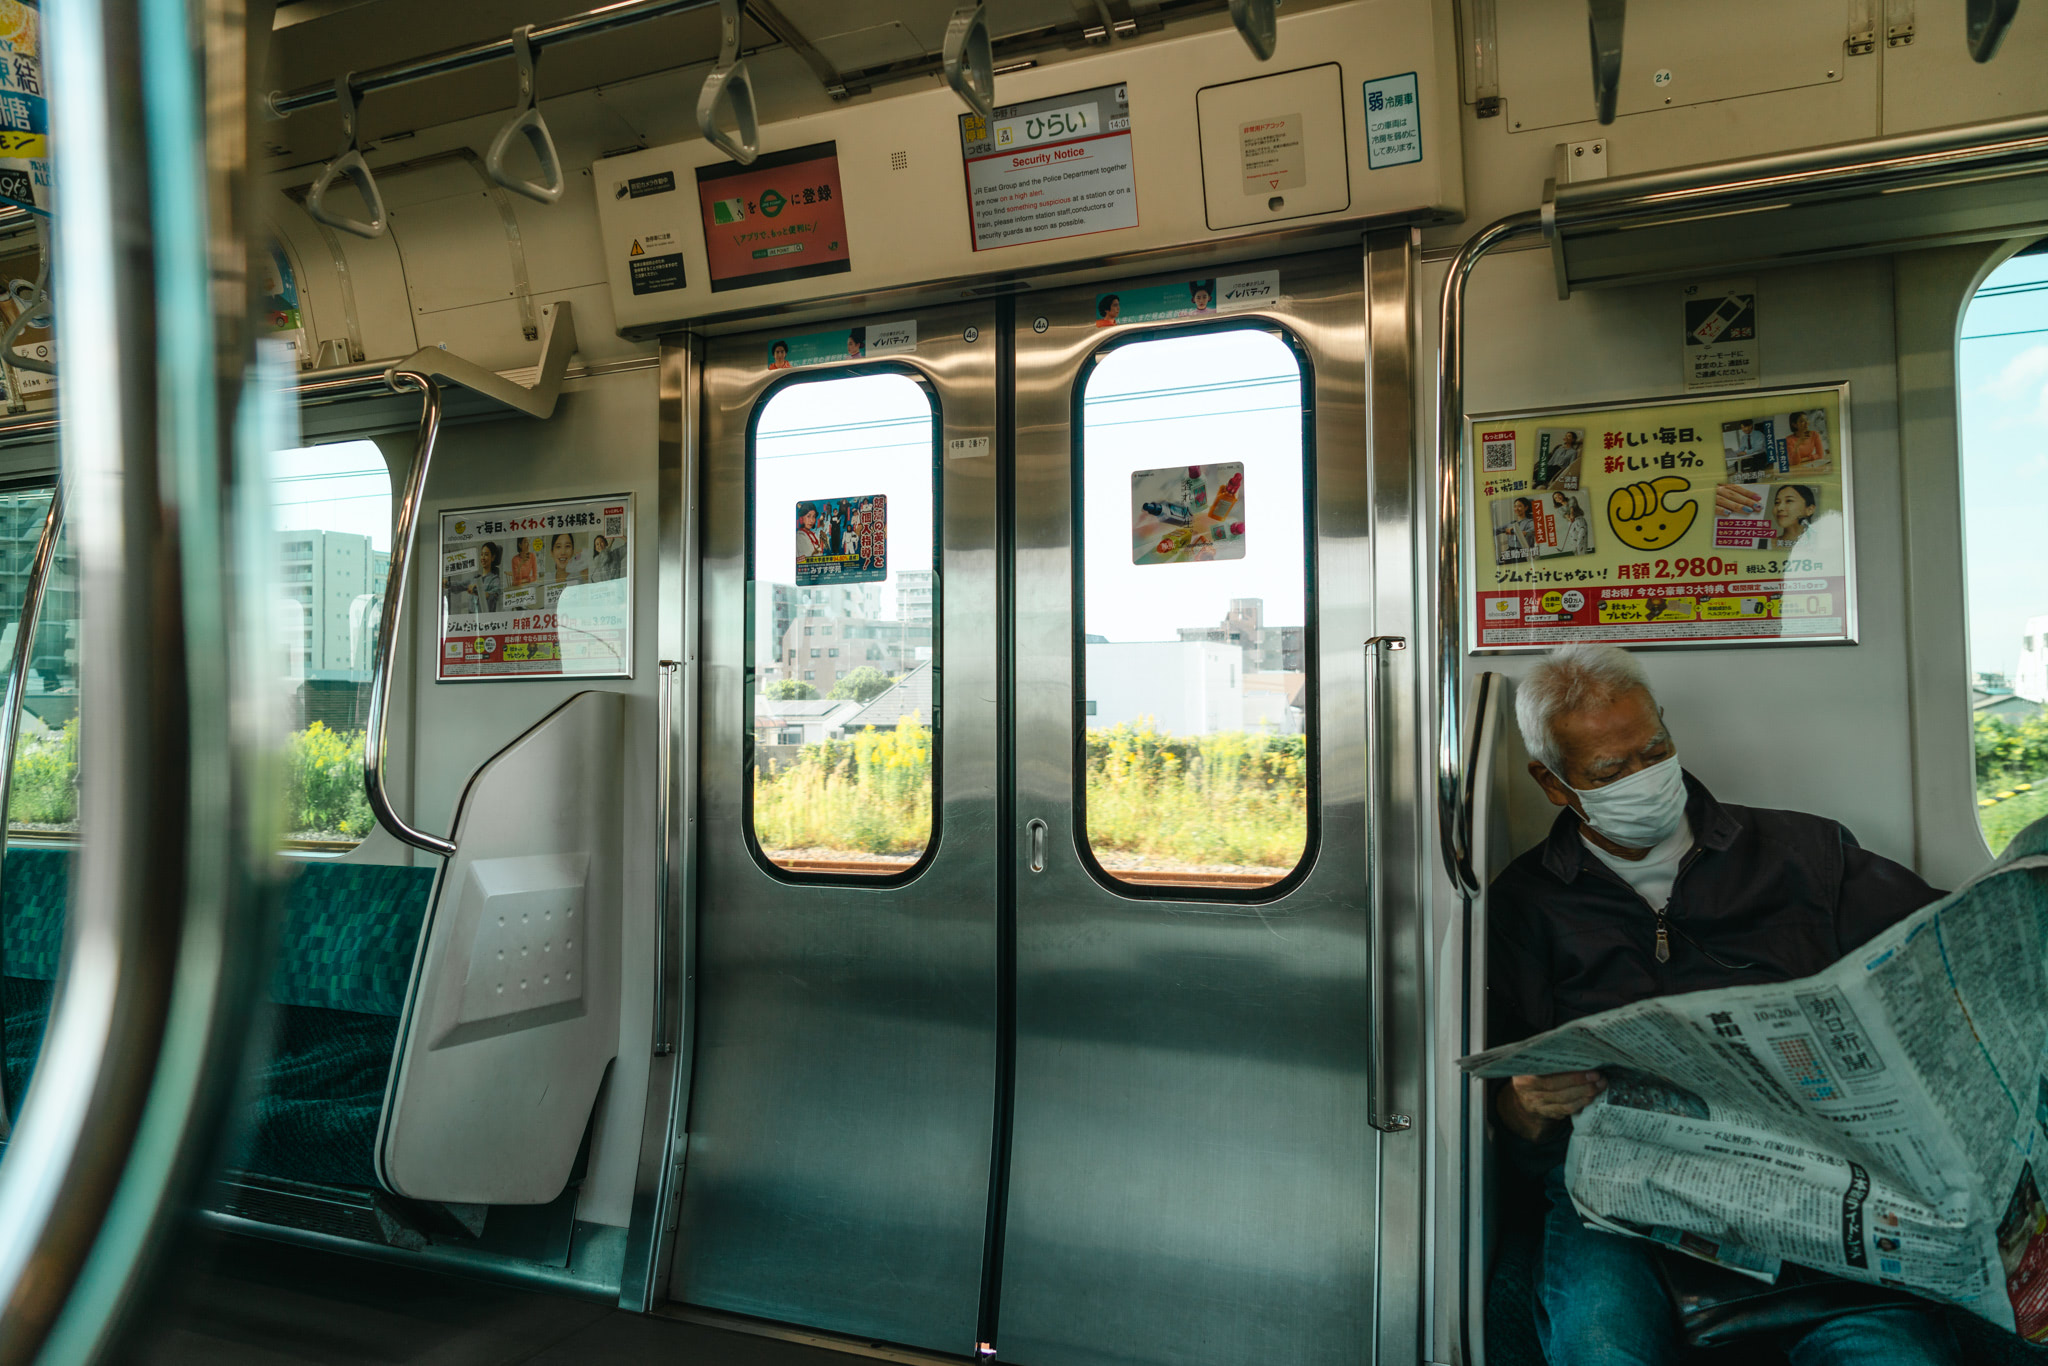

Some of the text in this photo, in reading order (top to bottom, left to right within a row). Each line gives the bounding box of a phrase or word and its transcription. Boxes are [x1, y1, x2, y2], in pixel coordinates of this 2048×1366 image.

[1656, 72, 1670, 83] 24
[1118, 89, 1126, 100] 4
[993, 107, 1017, 119] 中野 行
[964, 116, 986, 130] 各駅
[1026, 111, 1087, 140] ひらい
[1110, 119, 1130, 129] 14:01
[1371, 118, 1407, 132] この車両は
[965, 128, 987, 143] 停車
[1001, 134, 1010, 143] 24
[1371, 129, 1417, 145] 冷房を弱めに
[967, 143, 991, 155] つぎは
[1373, 142, 1416, 157] してあります。
[1012, 147, 1085, 169] Security Notice
[974, 187, 983, 196] JR
[984, 185, 997, 194] East
[998, 182, 1018, 192] Group
[1019, 180, 1031, 188] and
[1043, 175, 1062, 184] Police
[1063, 169, 1099, 181] Department
[1101, 163, 1128, 175] together
[748, 201, 757, 214] を
[791, 184, 833, 206] に登録
[976, 210, 981, 218] If
[982, 209, 993, 218] you
[994, 206, 1006, 214] find
[1006, 201, 1038, 213] something
[1039, 196, 1071, 209] suspicious
[1086, 190, 1107, 200] station
[1116, 187, 1125, 195] on
[986, 197, 999, 205] now
[1014, 191, 1028, 201] high
[1029, 189, 1045, 198] alert.
[977, 221, 993, 230] train,
[994, 217, 1014, 227] please
[1014, 214, 1034, 223] inform
[1035, 210, 1056, 220] station
[978, 230, 1002, 241] security
[1003, 227, 1024, 237] guards
[1033, 223, 1049, 231] soon
[1058, 217, 1085, 228] possible.
[777, 247, 790, 255] POINT
[1236, 286, 1271, 298] レバテック
[1035, 320, 1046, 329] 4A
[882, 335, 909, 346] レバテック
[1696, 350, 1744, 361] マナーモードに
[1695, 359, 1750, 370] 設定の上、通話は
[1695, 368, 1748, 379] ご遠慮ください。
[1484, 433, 1514, 441] もっと詳しく
[1604, 427, 1703, 450] 新しい毎日、
[1765, 421, 1776, 462] ワークスペース
[1604, 451, 1704, 474] 新しい自分。
[1778, 441, 1788, 471] セルフカフェ
[1483, 480, 1528, 496] 使い放題!
[1564, 482, 1578, 490] 時間
[475, 512, 602, 535] で毎日、わくわくする体験を。
[1533, 501, 1545, 543] フィットネス
[1734, 529, 1776, 537] ホワイトニング
[1733, 538, 1751, 546] ネイル
[1495, 557, 1823, 584] ジムだけじゃない! 月額 2,980円 税込 3,278円
[1601, 584, 1725, 598] 超お得! 今なら豪華3大特典
[1732, 584, 1762, 592] 期間限定
[1606, 611, 1642, 620] プレゼント
[447, 620, 508, 633] ジムだけじゃない!
[512, 617, 531, 630] 月額
[1810, 997, 1873, 1073] 朝日新聞
[1675, 1123, 1762, 1148] タクシー不足解消へ
